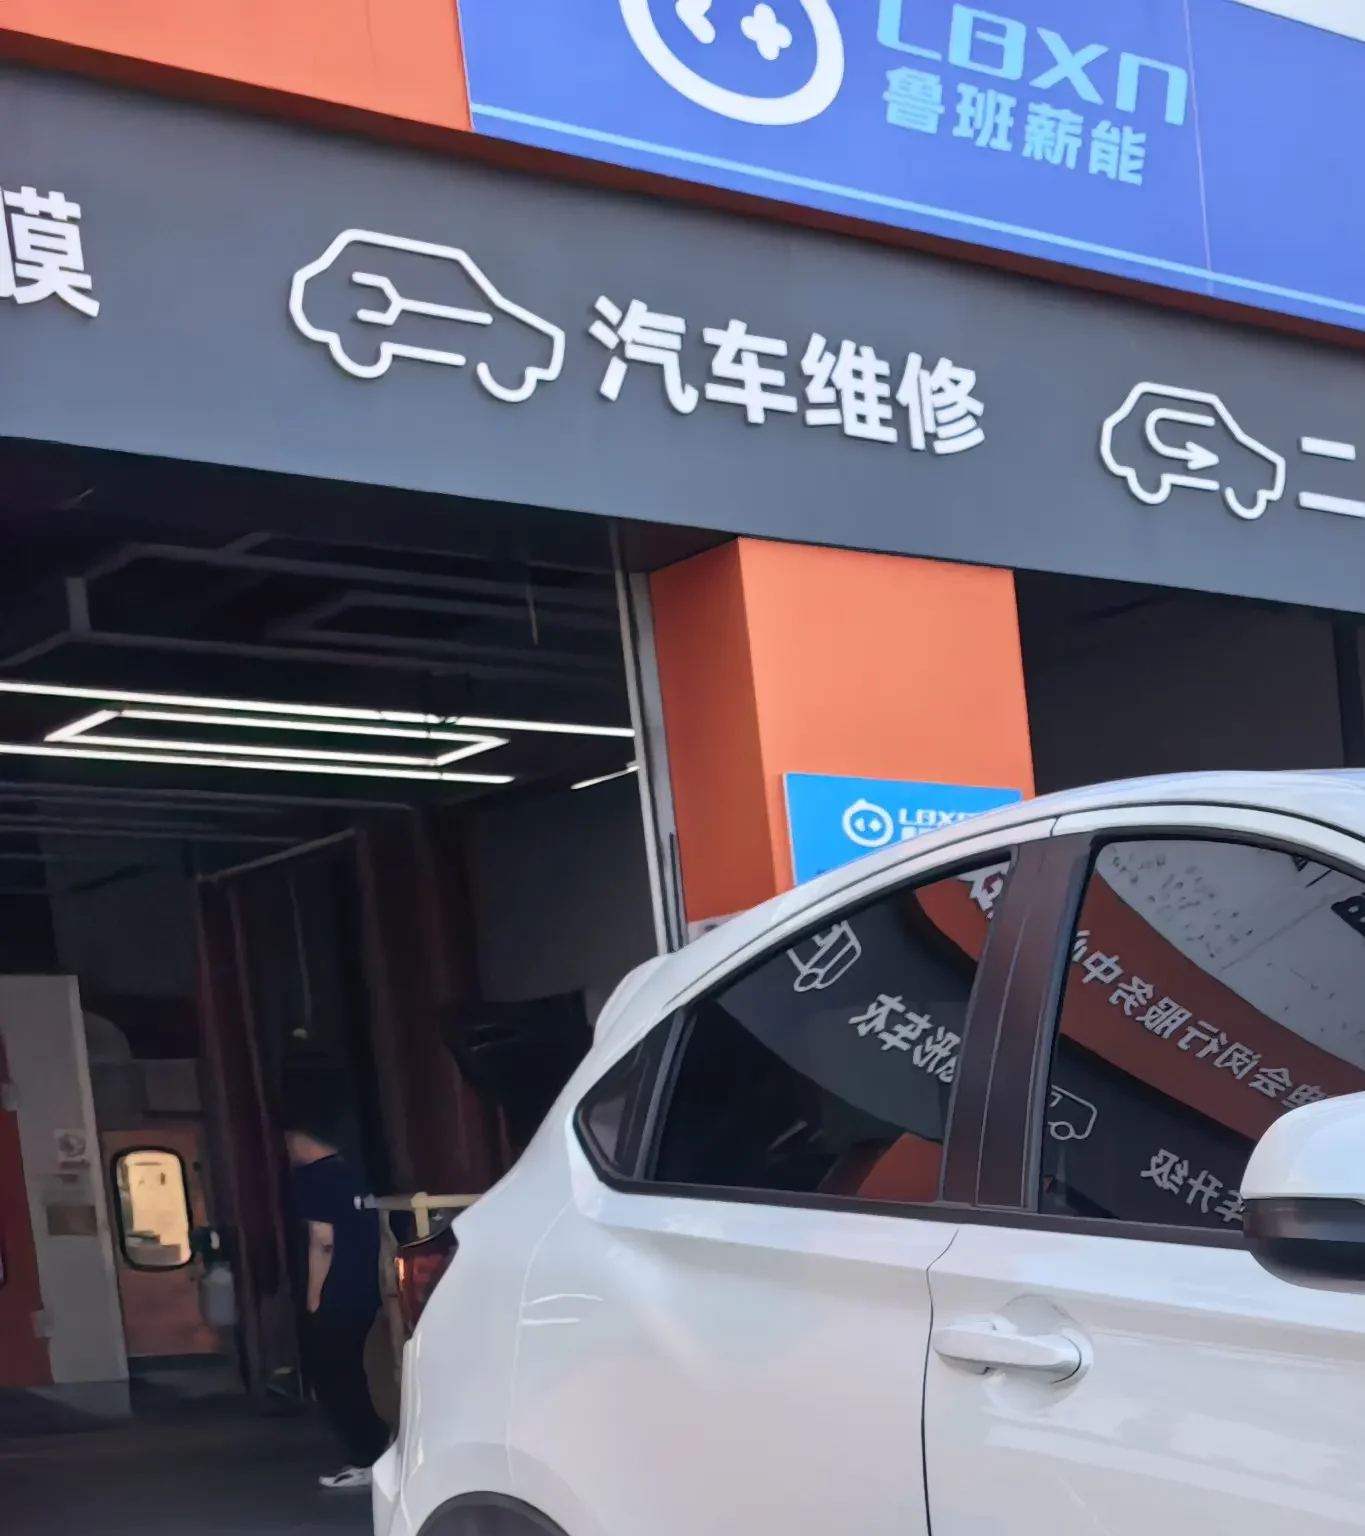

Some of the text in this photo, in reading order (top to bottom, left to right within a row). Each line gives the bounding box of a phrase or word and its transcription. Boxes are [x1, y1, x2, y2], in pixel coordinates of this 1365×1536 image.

[883, 66, 1147, 187] 鲁班薪能
[589, 295, 987, 456] 汽车维修
